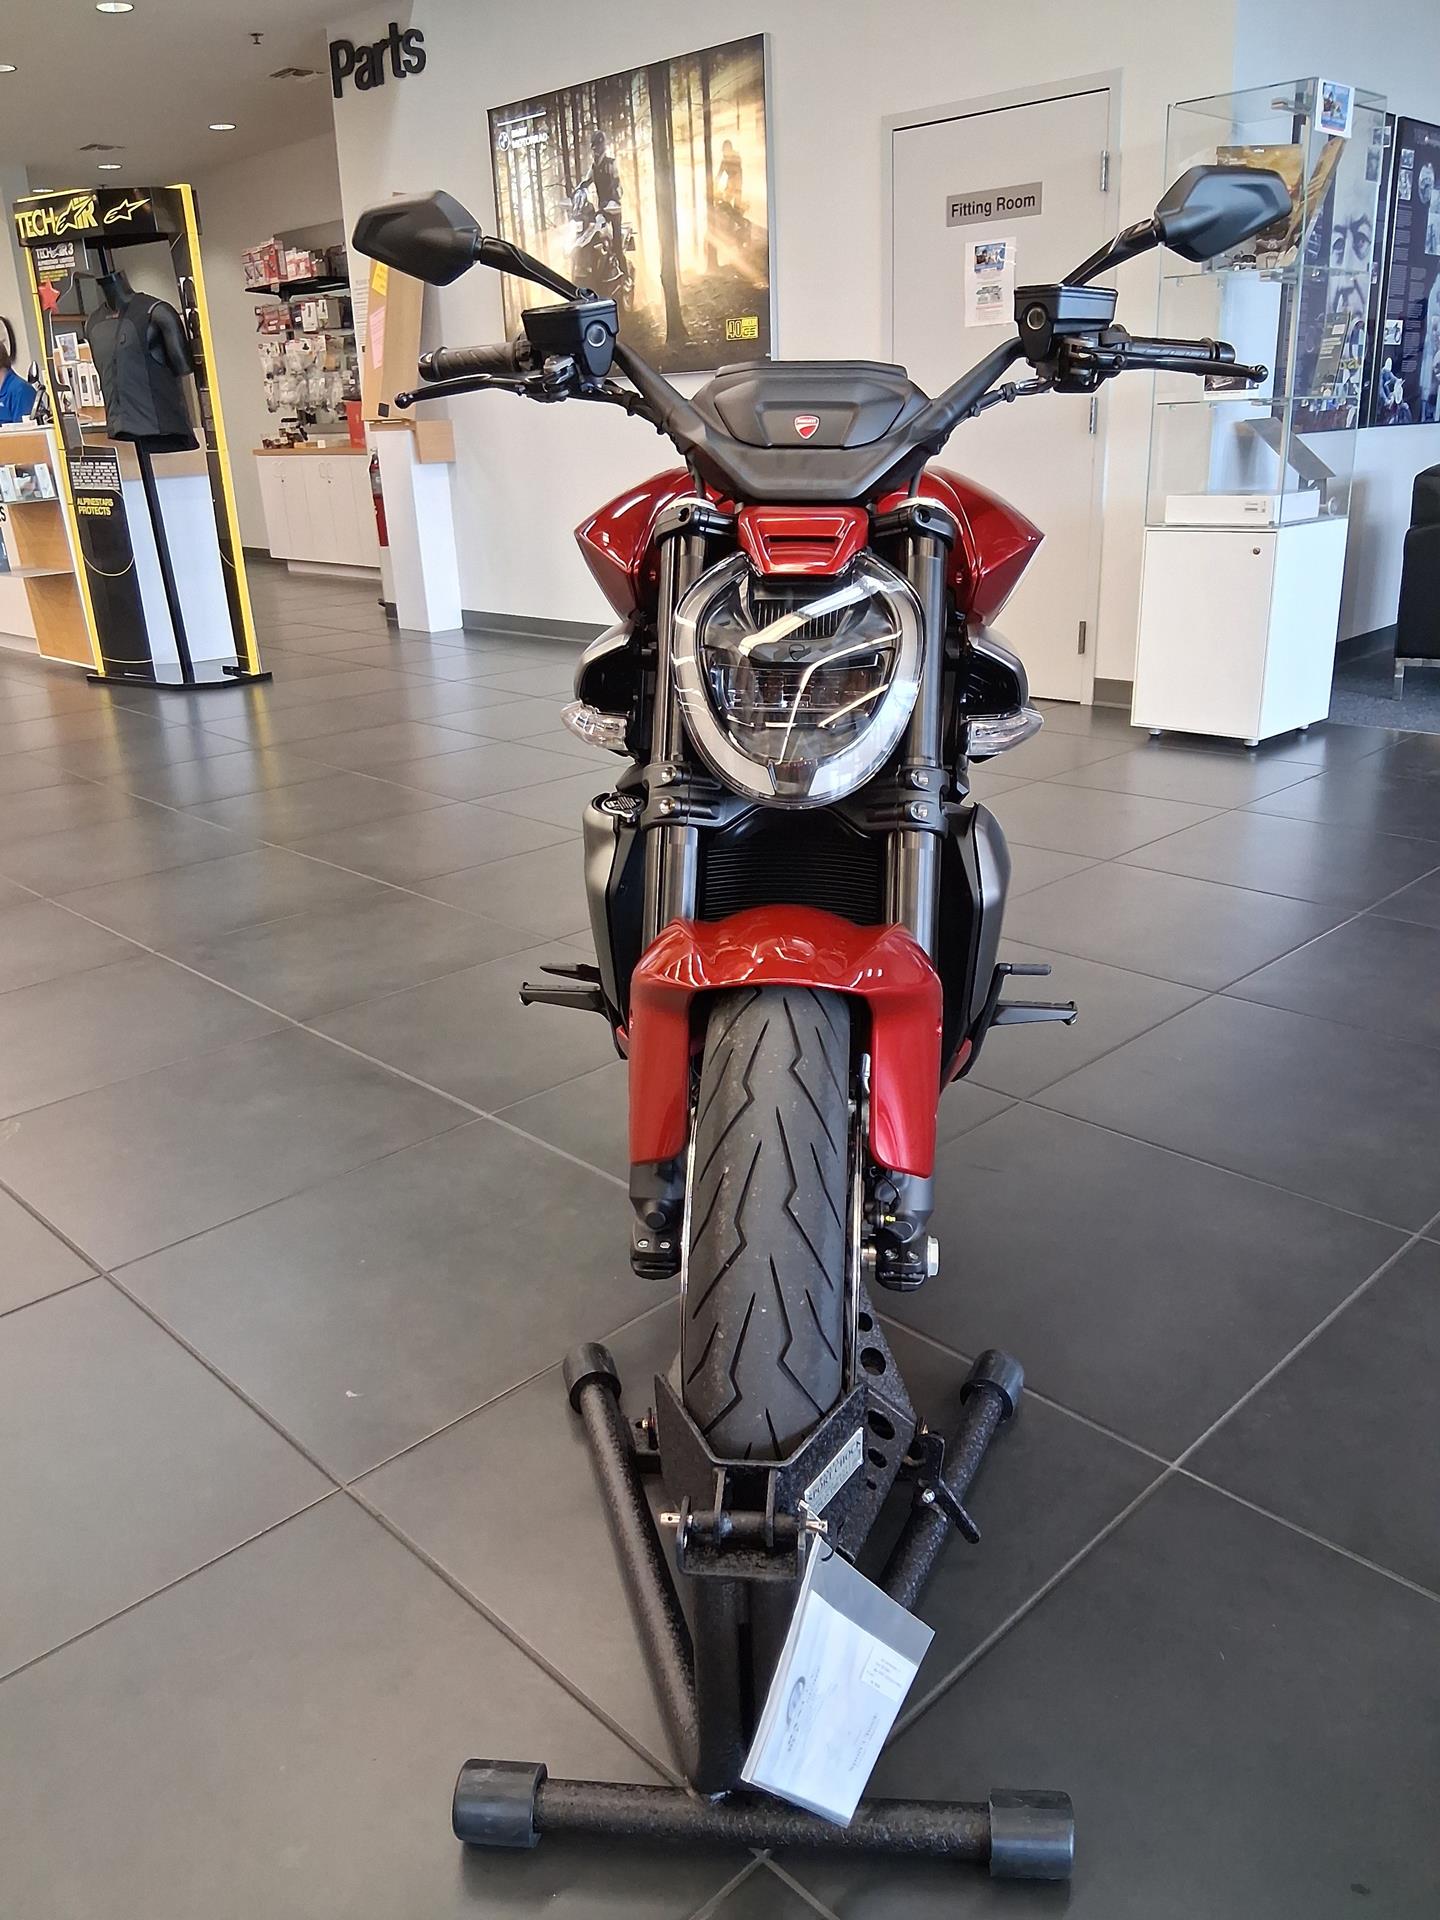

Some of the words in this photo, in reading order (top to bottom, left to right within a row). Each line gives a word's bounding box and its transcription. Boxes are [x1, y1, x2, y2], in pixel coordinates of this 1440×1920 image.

[329, 22, 427, 98] Parts
[951, 201, 992, 217] Fitting
[996, 195, 1036, 211] Room
[77, 505, 112, 516] PROTECTS
